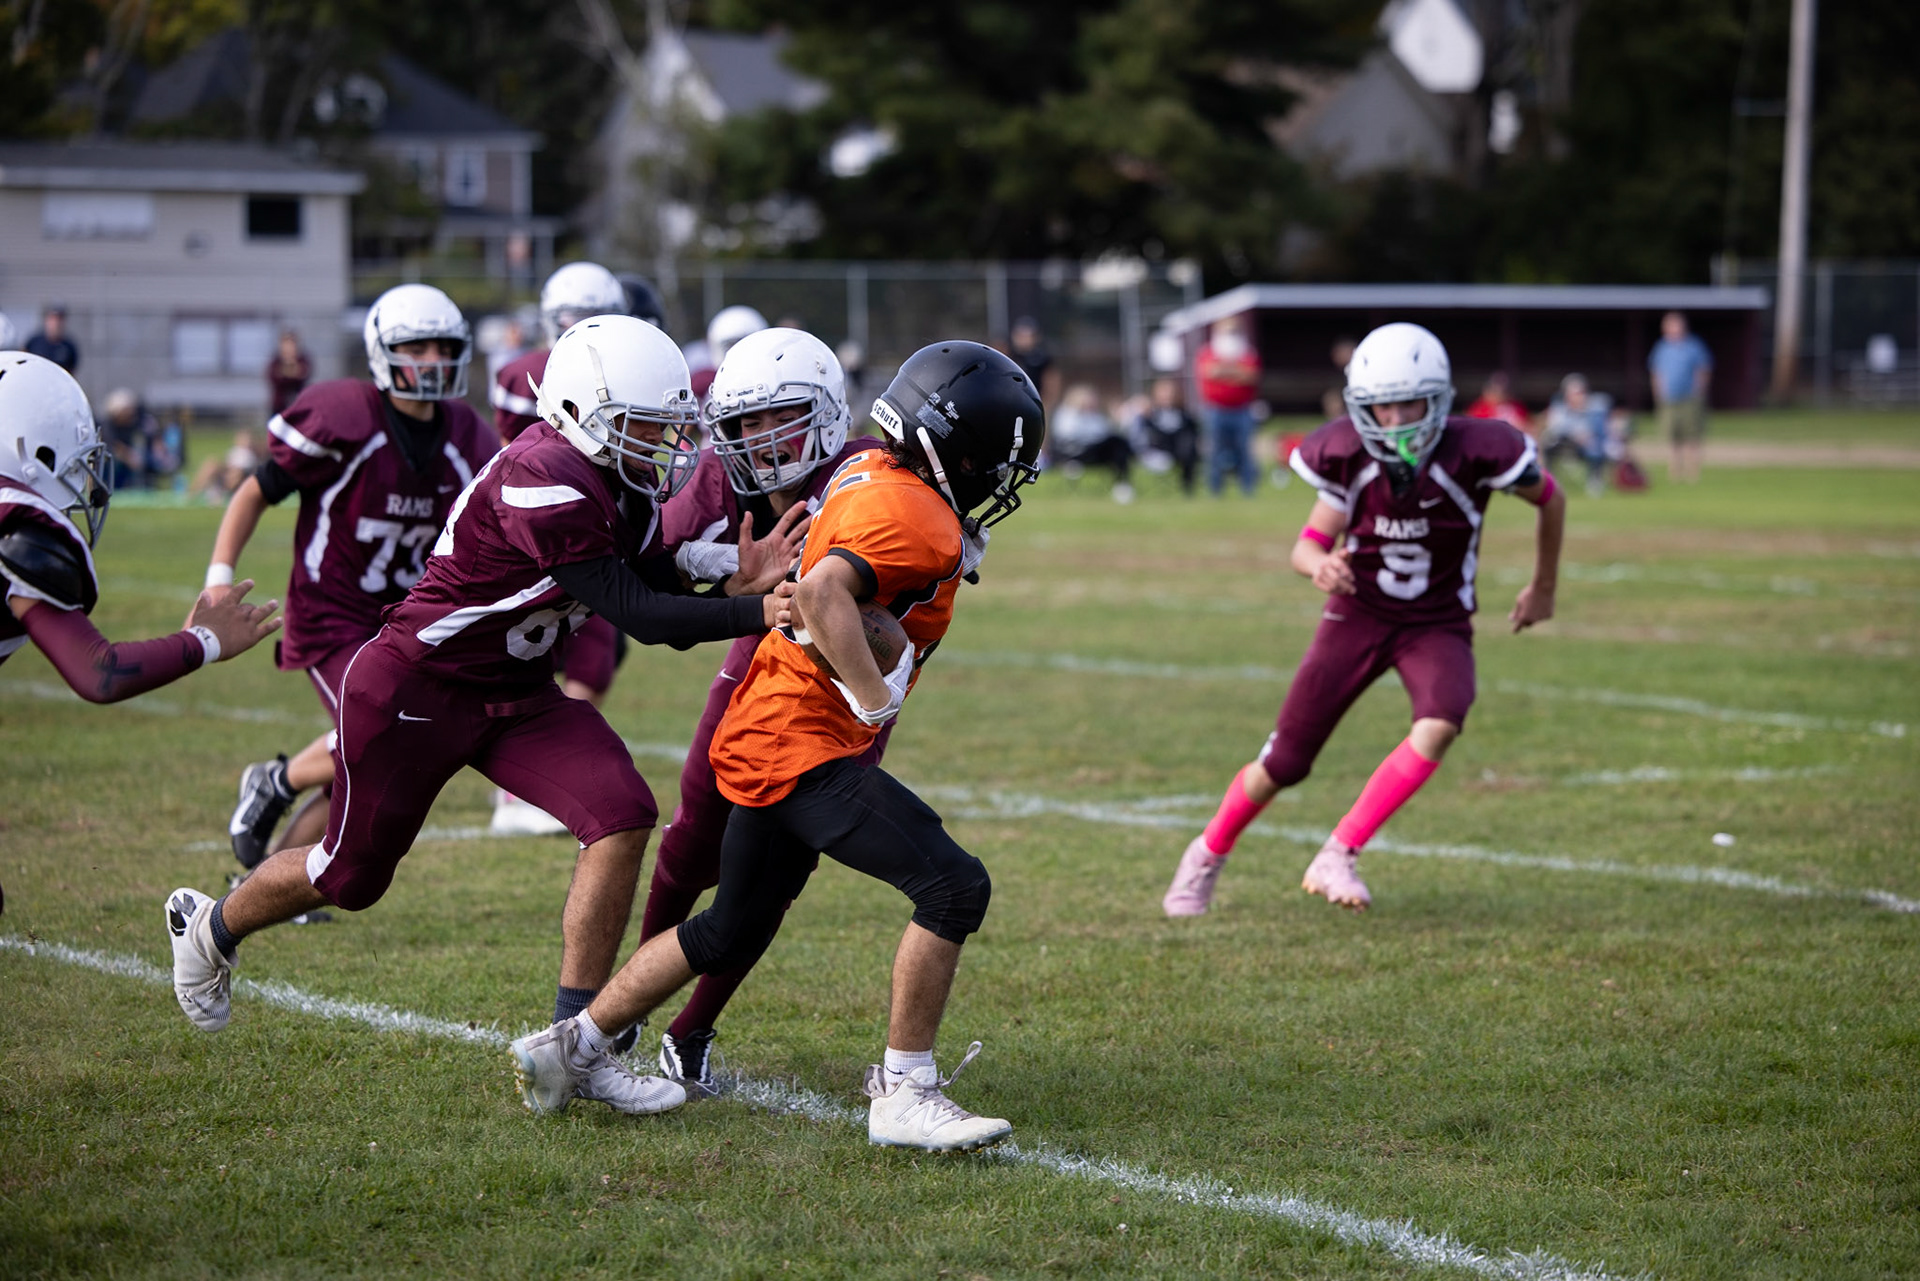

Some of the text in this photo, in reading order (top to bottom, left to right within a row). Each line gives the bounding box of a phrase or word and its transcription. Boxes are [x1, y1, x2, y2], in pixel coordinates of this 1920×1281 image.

[874, 403, 899, 430] schutt
[386, 493, 434, 518] RAMS
[1374, 515, 1429, 540] RAMS
[356, 516, 438, 593] 73
[1377, 542, 1432, 600] 9
